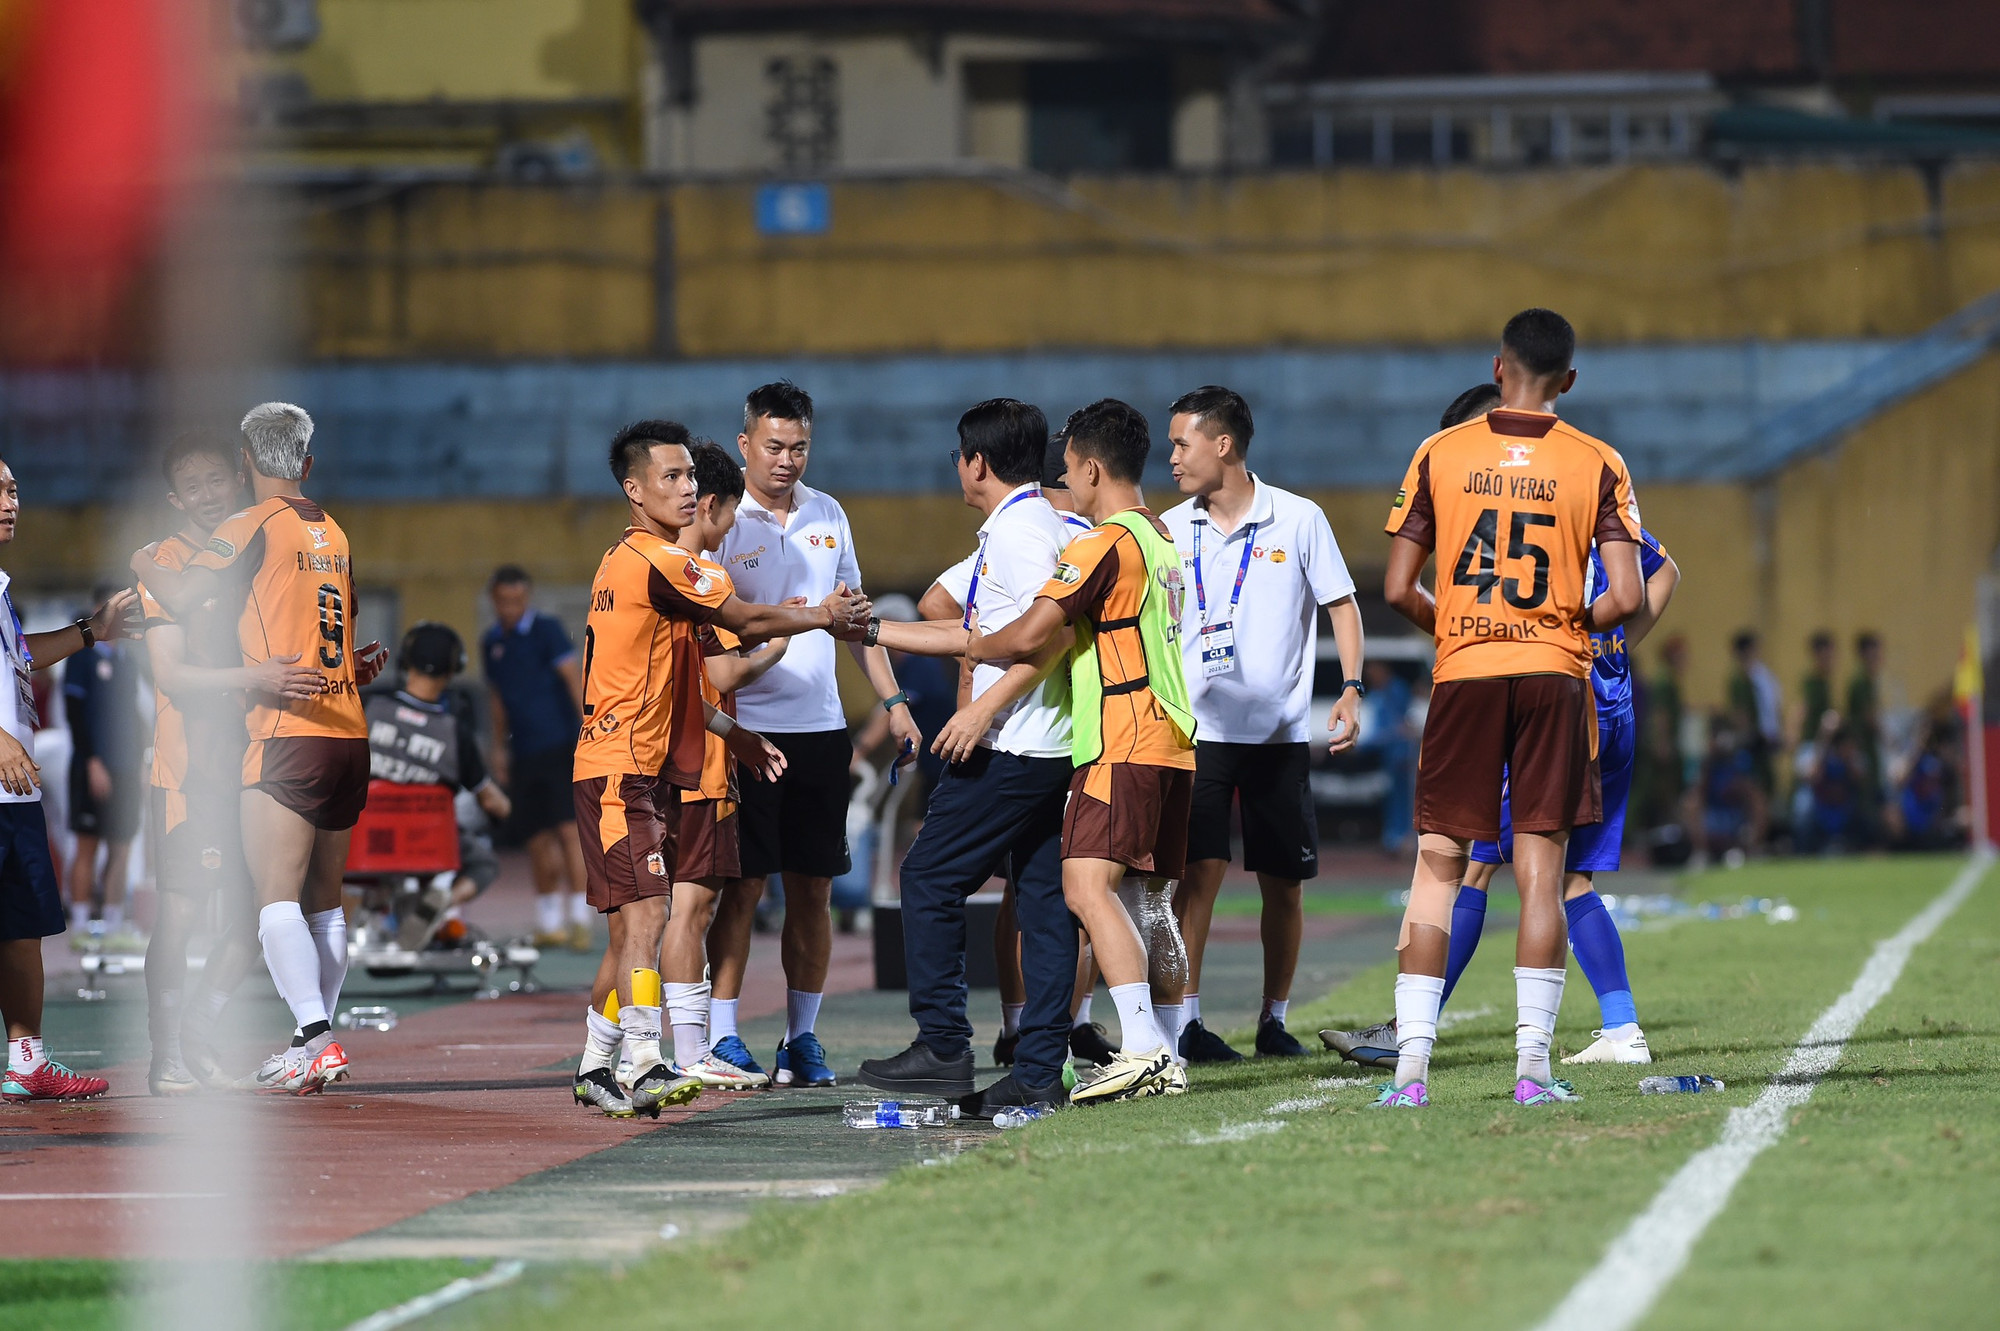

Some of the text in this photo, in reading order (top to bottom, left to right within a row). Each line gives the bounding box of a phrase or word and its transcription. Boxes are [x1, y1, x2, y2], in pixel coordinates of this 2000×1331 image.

[1463, 468, 1557, 502] JOÃO VERAS
[730, 550, 761, 564] LPBank
[743, 558, 760, 570] TQV
[1453, 508, 1556, 610] 45
[594, 586, 614, 612] SƠN
[317, 583, 344, 669] 9
[1448, 616, 1539, 639] LPBank
[1210, 648, 1227, 659] CLB
